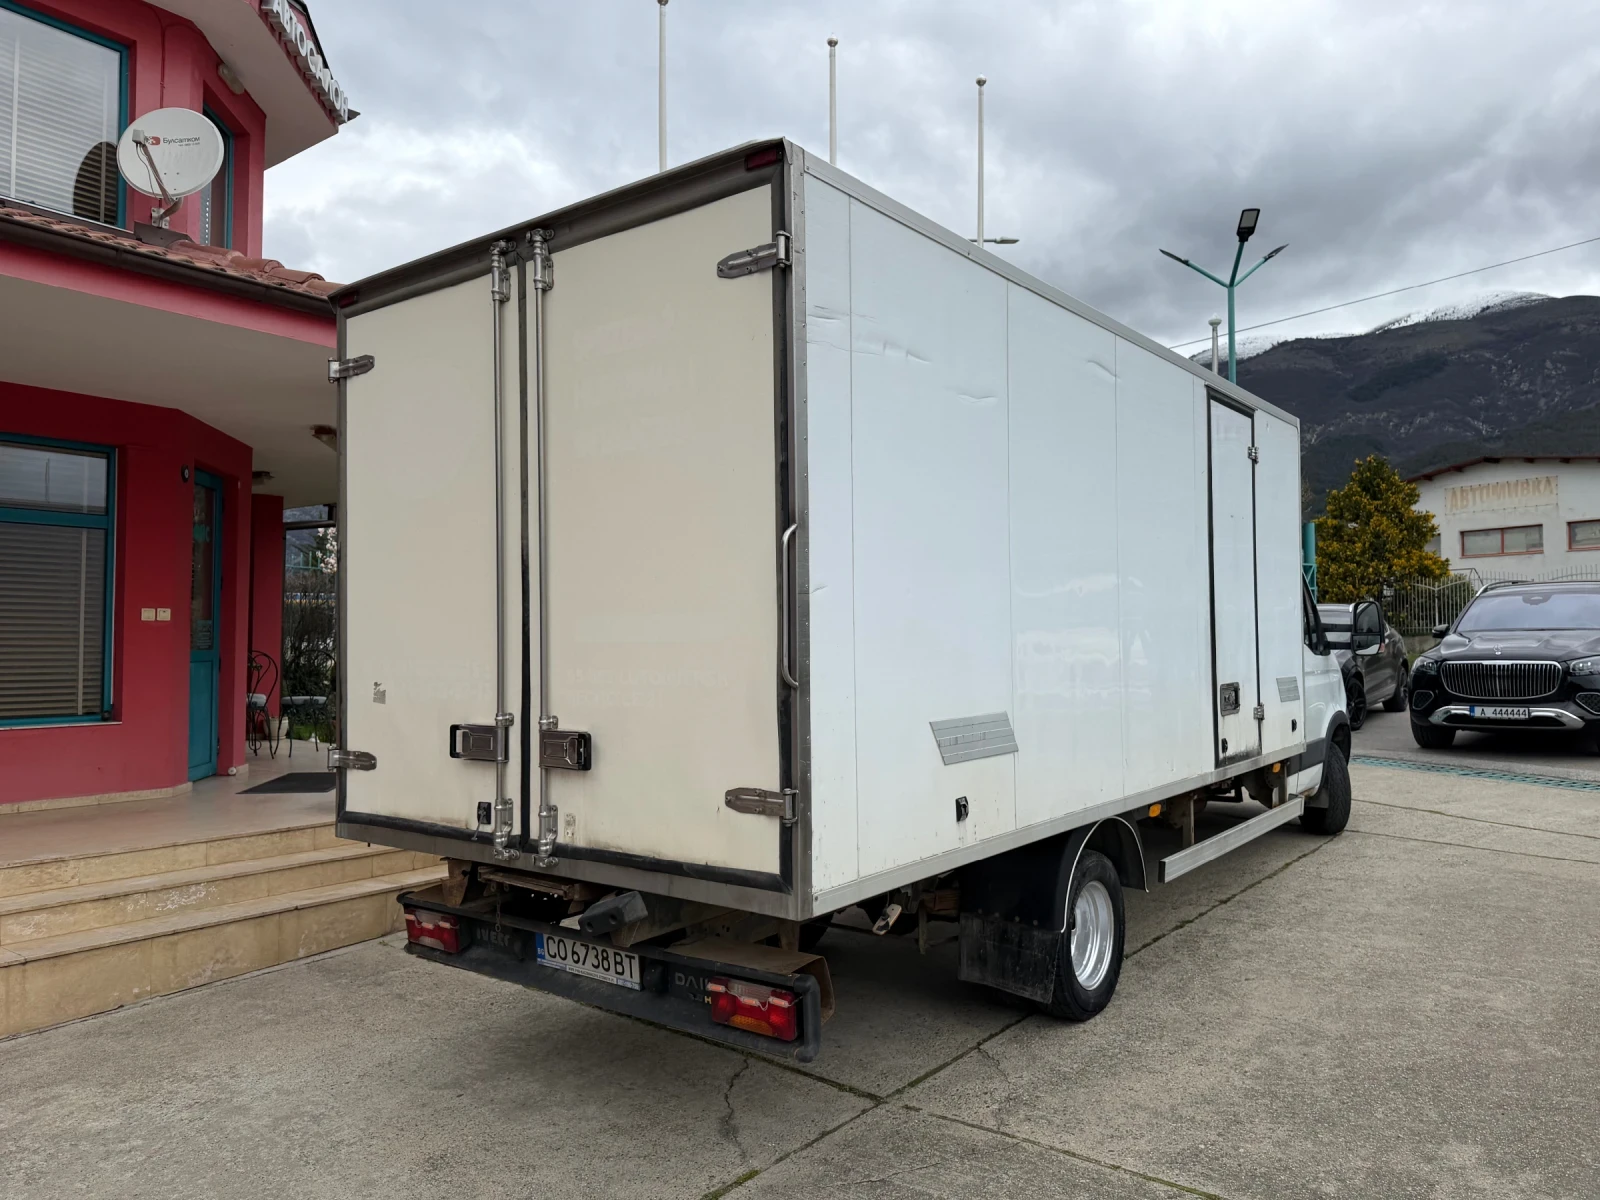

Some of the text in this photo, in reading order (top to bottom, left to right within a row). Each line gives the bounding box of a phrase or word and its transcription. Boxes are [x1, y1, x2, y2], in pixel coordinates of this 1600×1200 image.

[1450, 477, 1554, 513] АВТОМИВКА
[1480, 707, 1487, 716] A
[1491, 708, 1527, 717] 444444
[537, 947, 545, 956] BG
[546, 935, 568, 961] CO
[571, 941, 611, 973] 6738
[613, 951, 636, 979] BT
